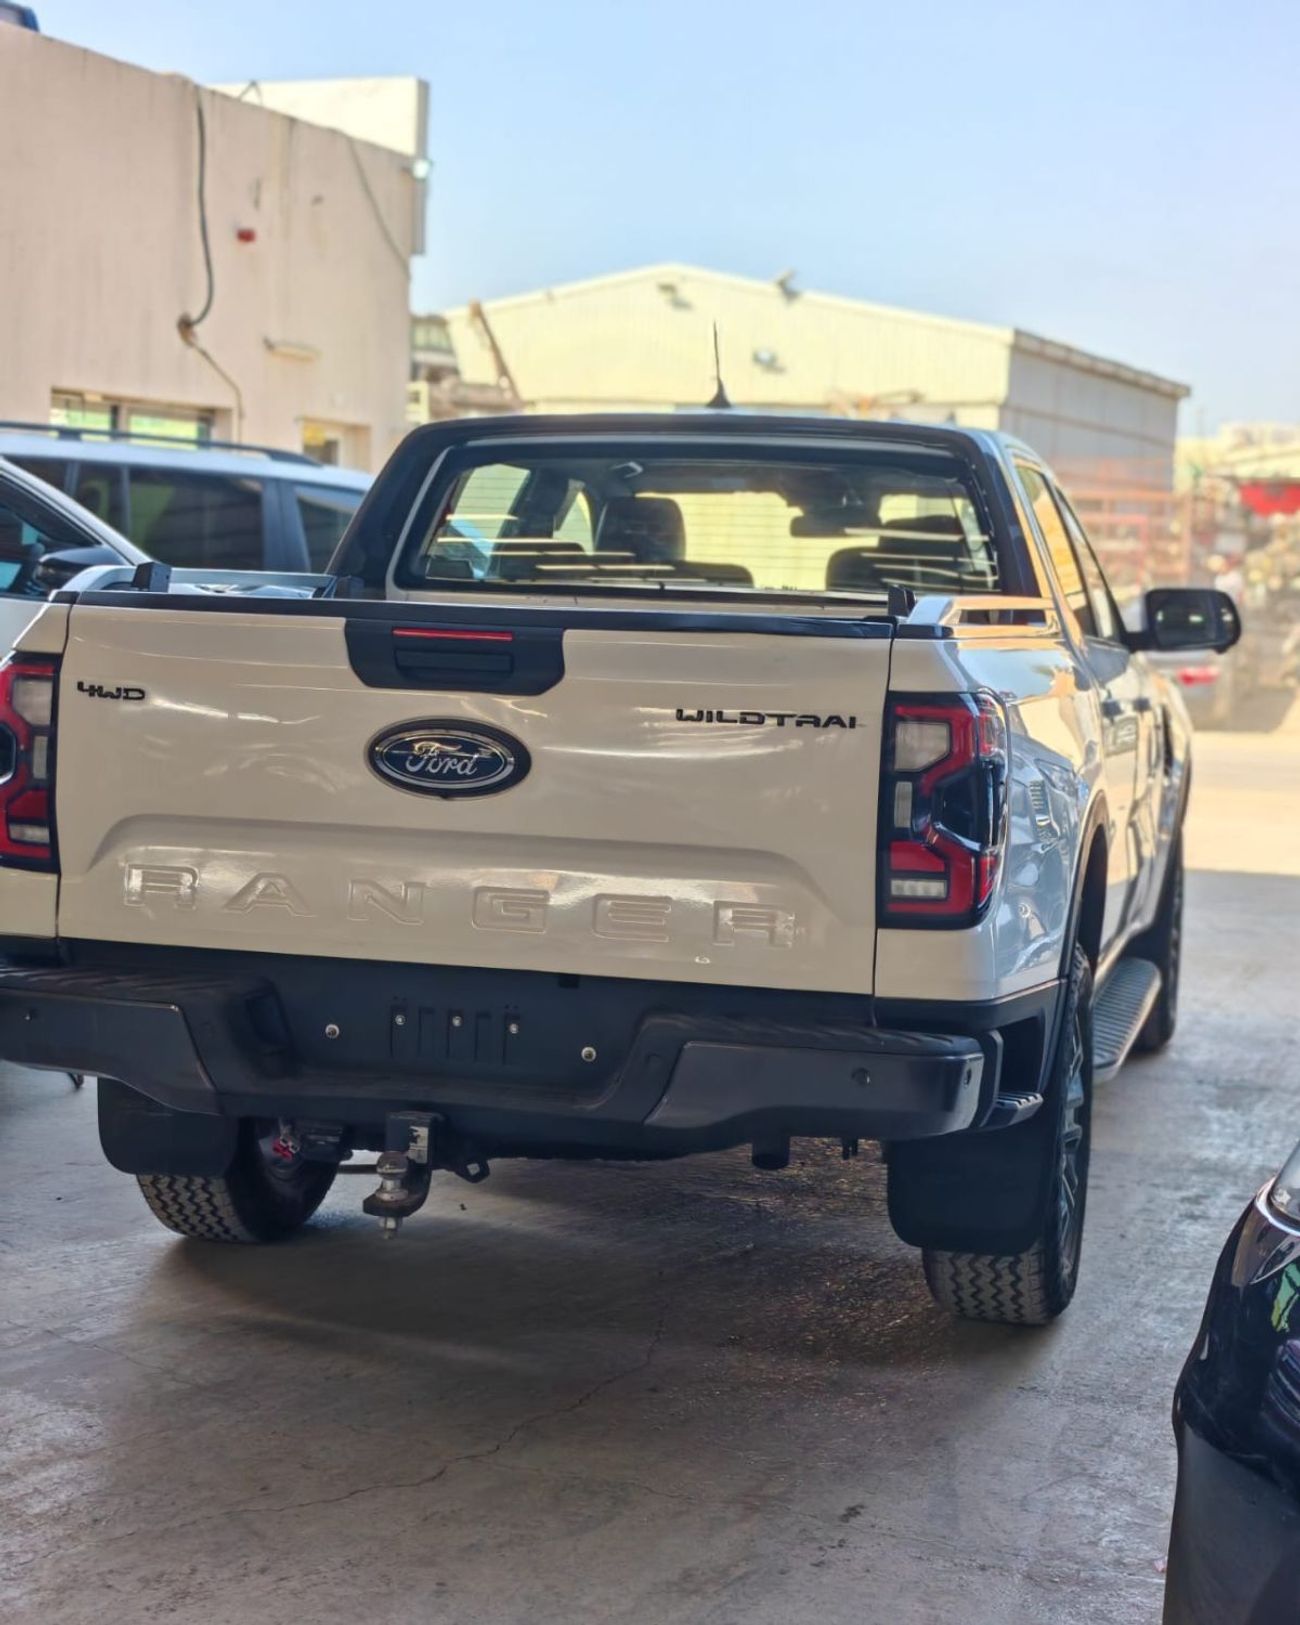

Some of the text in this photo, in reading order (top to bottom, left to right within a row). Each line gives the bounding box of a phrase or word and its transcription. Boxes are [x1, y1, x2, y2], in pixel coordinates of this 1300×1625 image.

[77, 681, 145, 700] 4WD
[405, 741, 478, 775] Ford
[124, 864, 796, 947] RANGER
